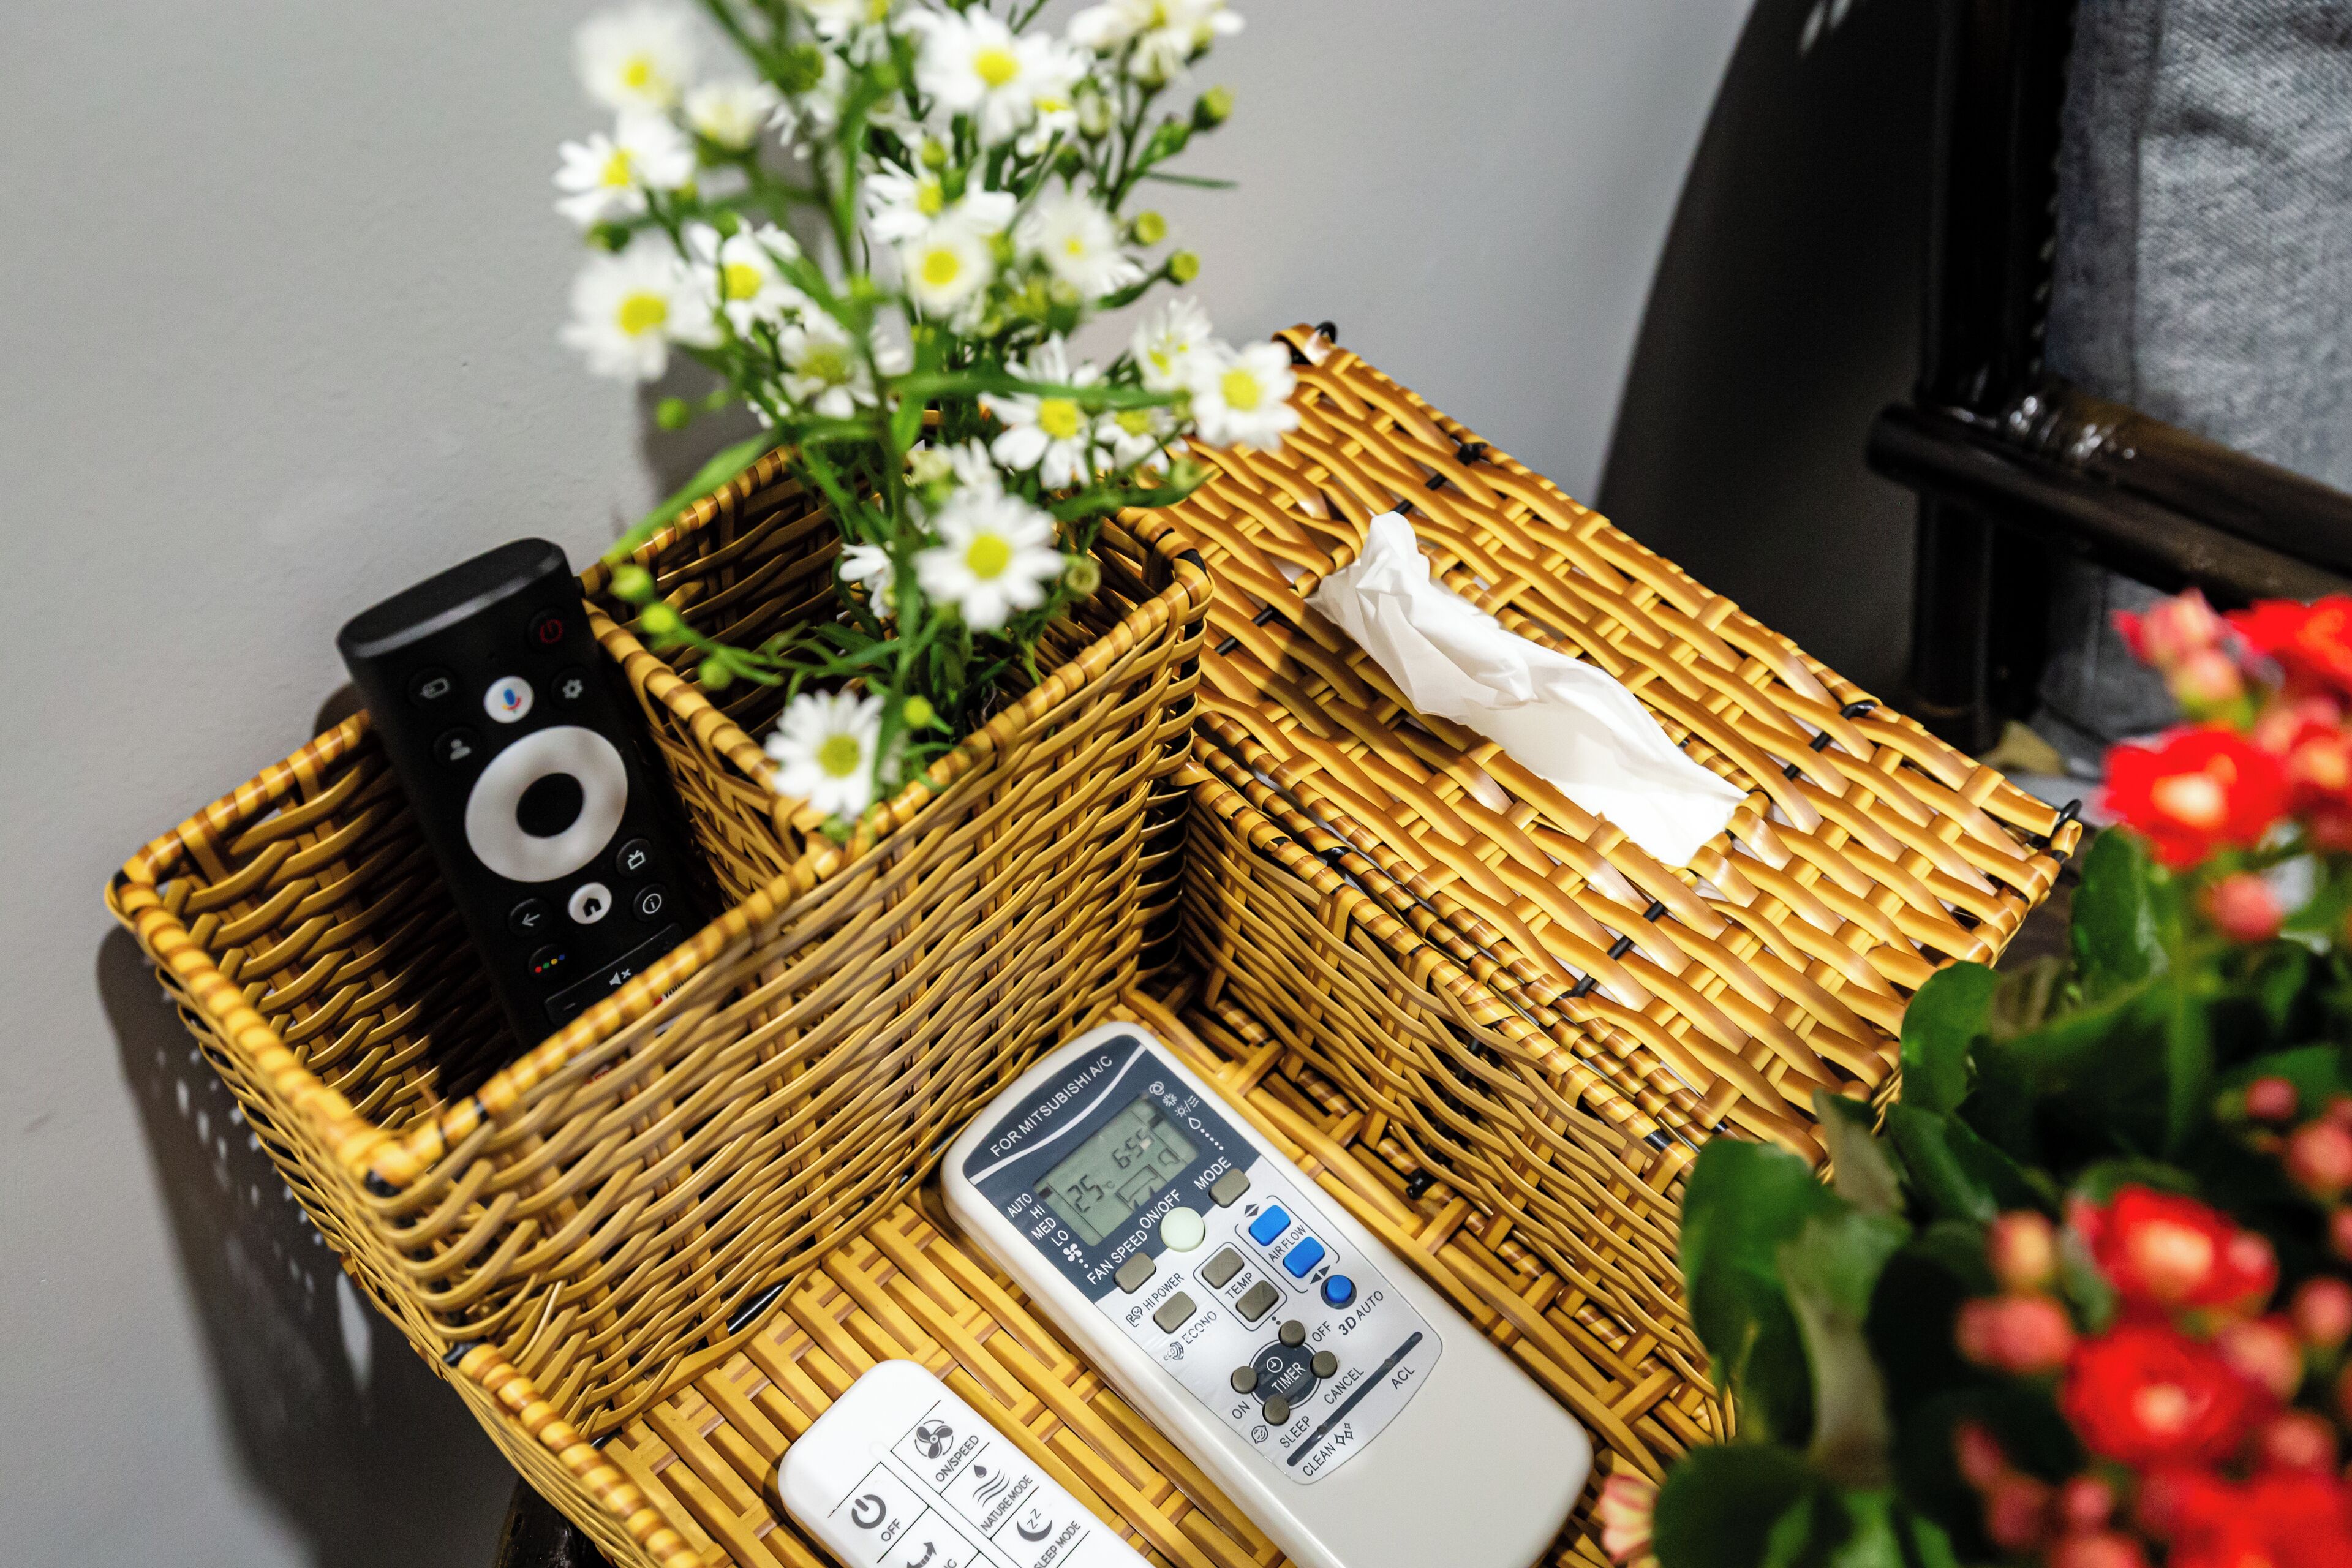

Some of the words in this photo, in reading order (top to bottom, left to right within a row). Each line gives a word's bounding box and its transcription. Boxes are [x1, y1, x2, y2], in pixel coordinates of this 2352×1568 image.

[990, 1130, 1022, 1158] FOR
[1017, 1072, 1092, 1135] MITSUBISHI
[1088, 1055, 1112, 1078] A/C
[1193, 1156, 1232, 1191] MODE
[1007, 1193, 1033, 1218] AUTO
[1030, 1204, 1046, 1219] HI
[1139, 1189, 1180, 1229] ON/OFF
[1031, 1217, 1057, 1240] MED
[1050, 1230, 1069, 1247] LO
[1268, 1245, 1285, 1262] AIR
[1282, 1224, 1306, 1248] FLOW
[1087, 1259, 1114, 1285] FAN
[1110, 1229, 1148, 1264] SPEED
[1142, 1297, 1156, 1311] HI
[1152, 1273, 1185, 1303] POWER
[1225, 1272, 1253, 1299] TEMP
[1182, 1311, 1217, 1344] ECONO
[1338, 1316, 1357, 1336] 3D
[1355, 1291, 1384, 1321] AUTO
[1311, 1321, 1332, 1342] OFF
[1271, 1362, 1306, 1394] TIMER
[1324, 1366, 1364, 1405] CANCEL
[1391, 1366, 1415, 1389] ACL
[1231, 1401, 1251, 1419] ON
[1279, 1415, 1310, 1449] SLEEP
[935, 1434, 979, 1482] ON/SPEED
[1302, 1442, 1336, 1476] CLEAN
[980, 1497, 1012, 1532] NATURE
[1007, 1474, 1033, 1501] MODE
[881, 1518, 902, 1542] OFF
[1055, 1520, 1081, 1548] MODE
